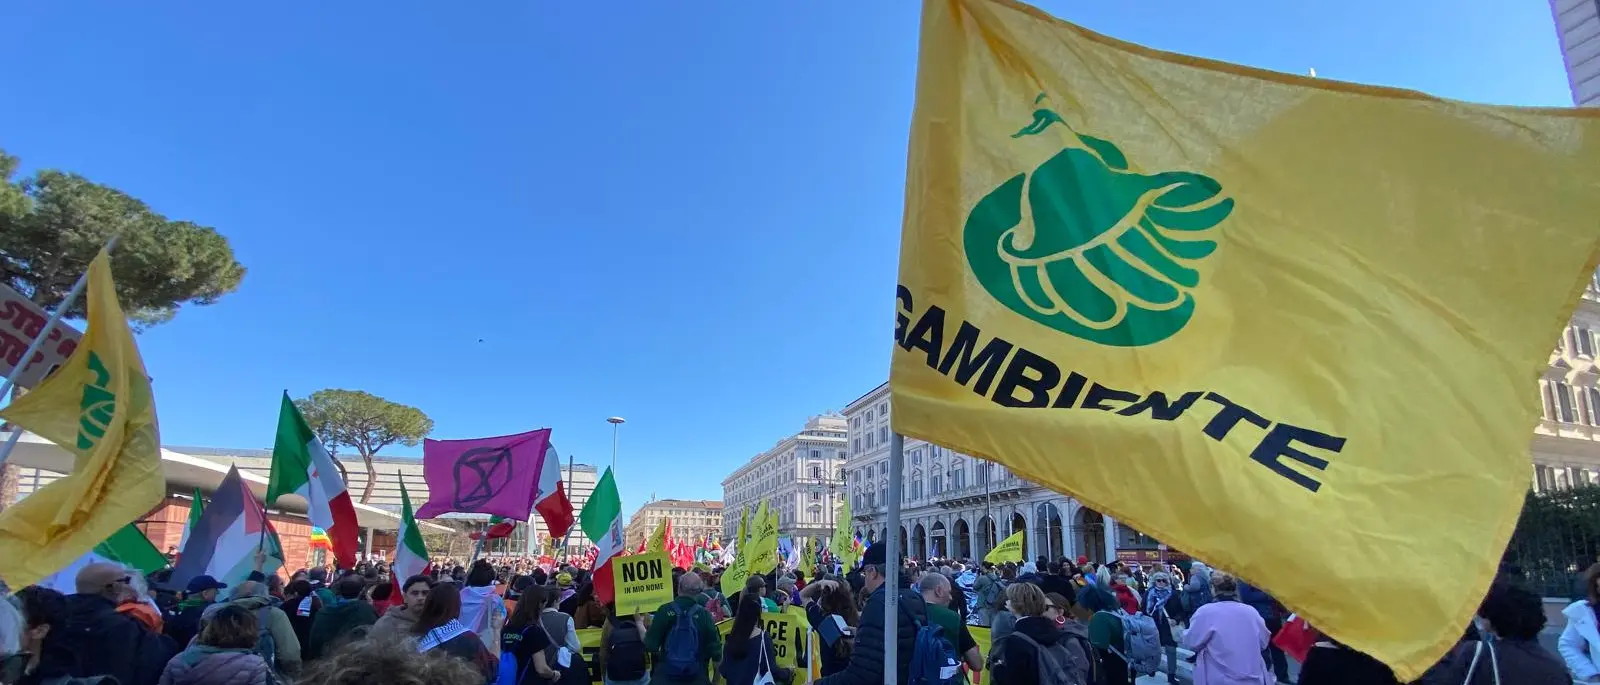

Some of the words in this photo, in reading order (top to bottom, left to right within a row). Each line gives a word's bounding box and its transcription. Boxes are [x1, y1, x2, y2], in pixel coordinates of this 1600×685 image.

[622, 559, 663, 582] NON
[633, 585, 645, 593] MIO
[646, 583, 664, 591] NOME
